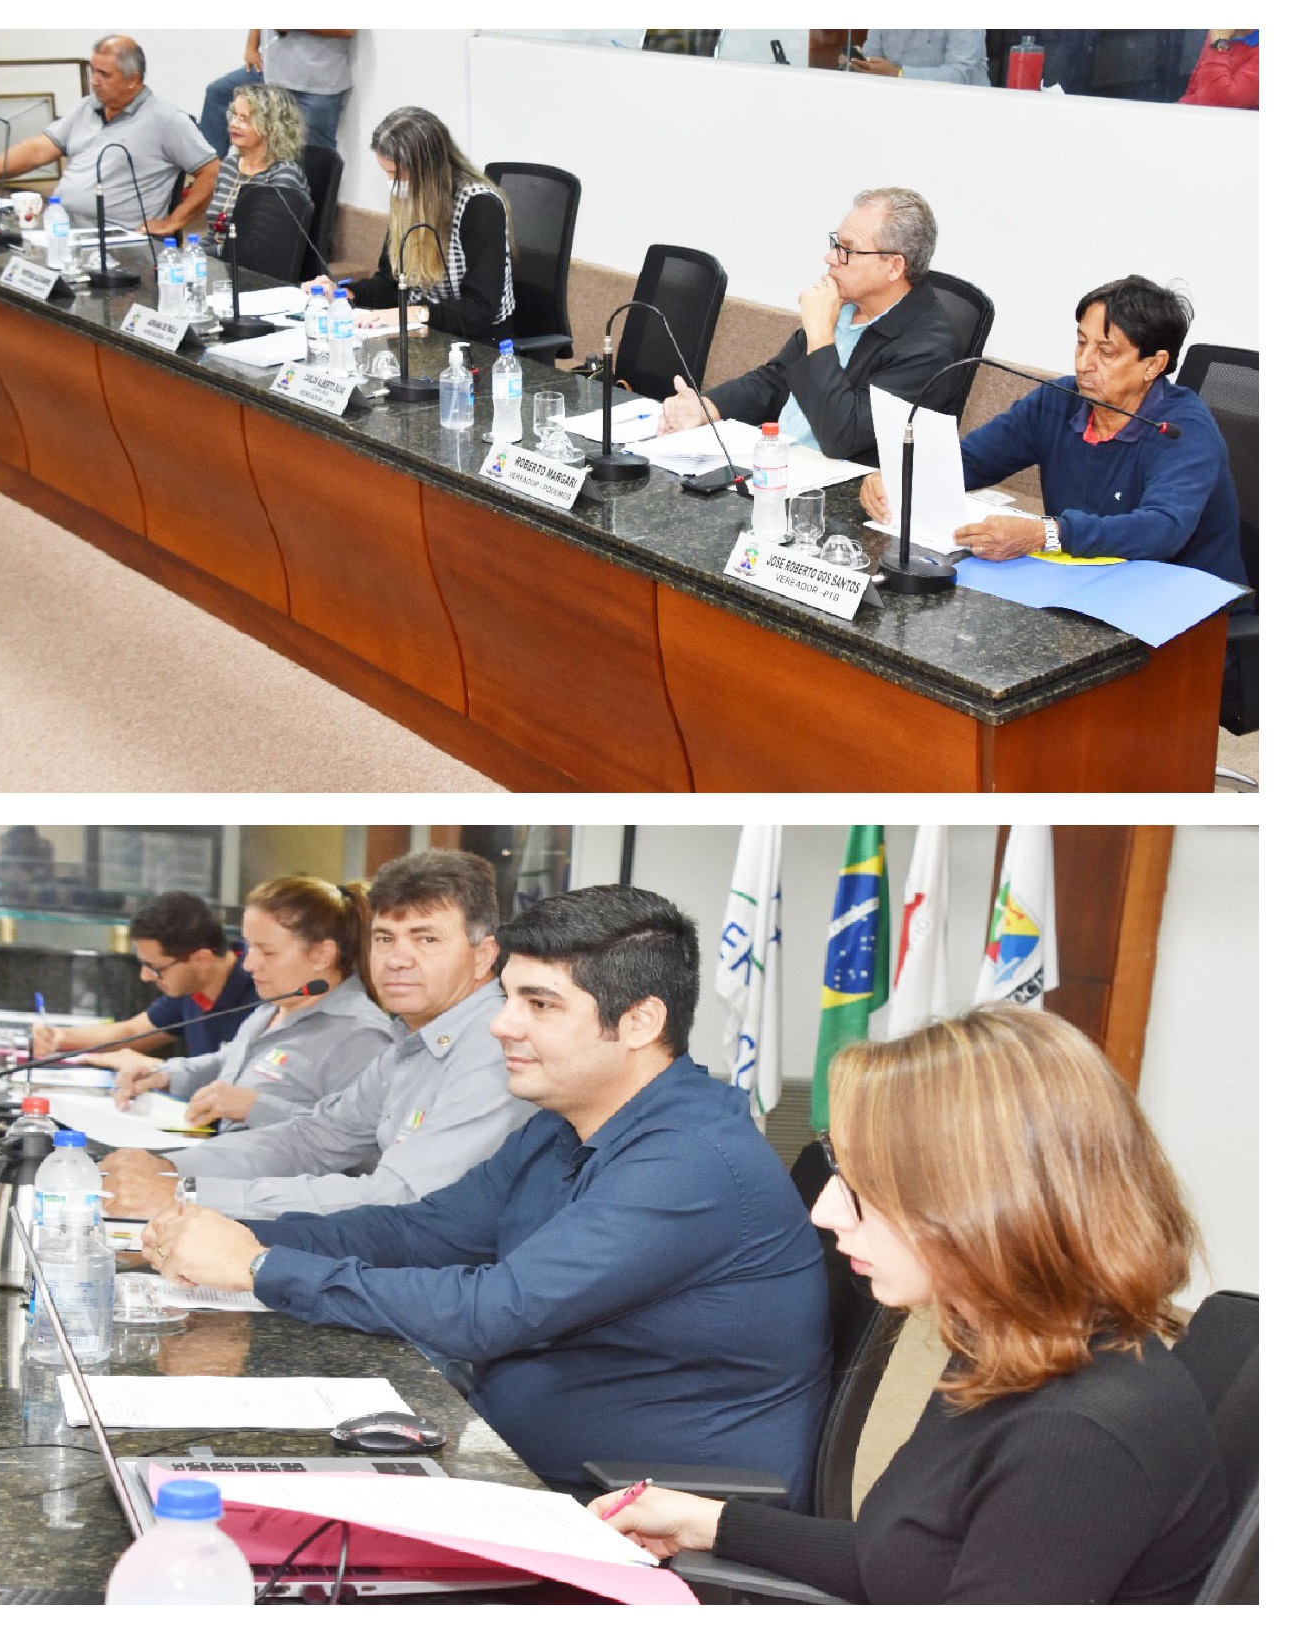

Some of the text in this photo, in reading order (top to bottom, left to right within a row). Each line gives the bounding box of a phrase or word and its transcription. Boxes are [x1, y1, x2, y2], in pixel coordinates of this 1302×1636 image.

[509, 471, 539, 488] VEREADOR
[542, 484, 572, 501] PODEMOS
[514, 456, 578, 489] ROBERTO MARGARI
[766, 554, 861, 594] JOSÉ ROBERTO DOS SANTOS
[775, 573, 819, 595] VEREADOR
[822, 590, 840, 602] PTB
